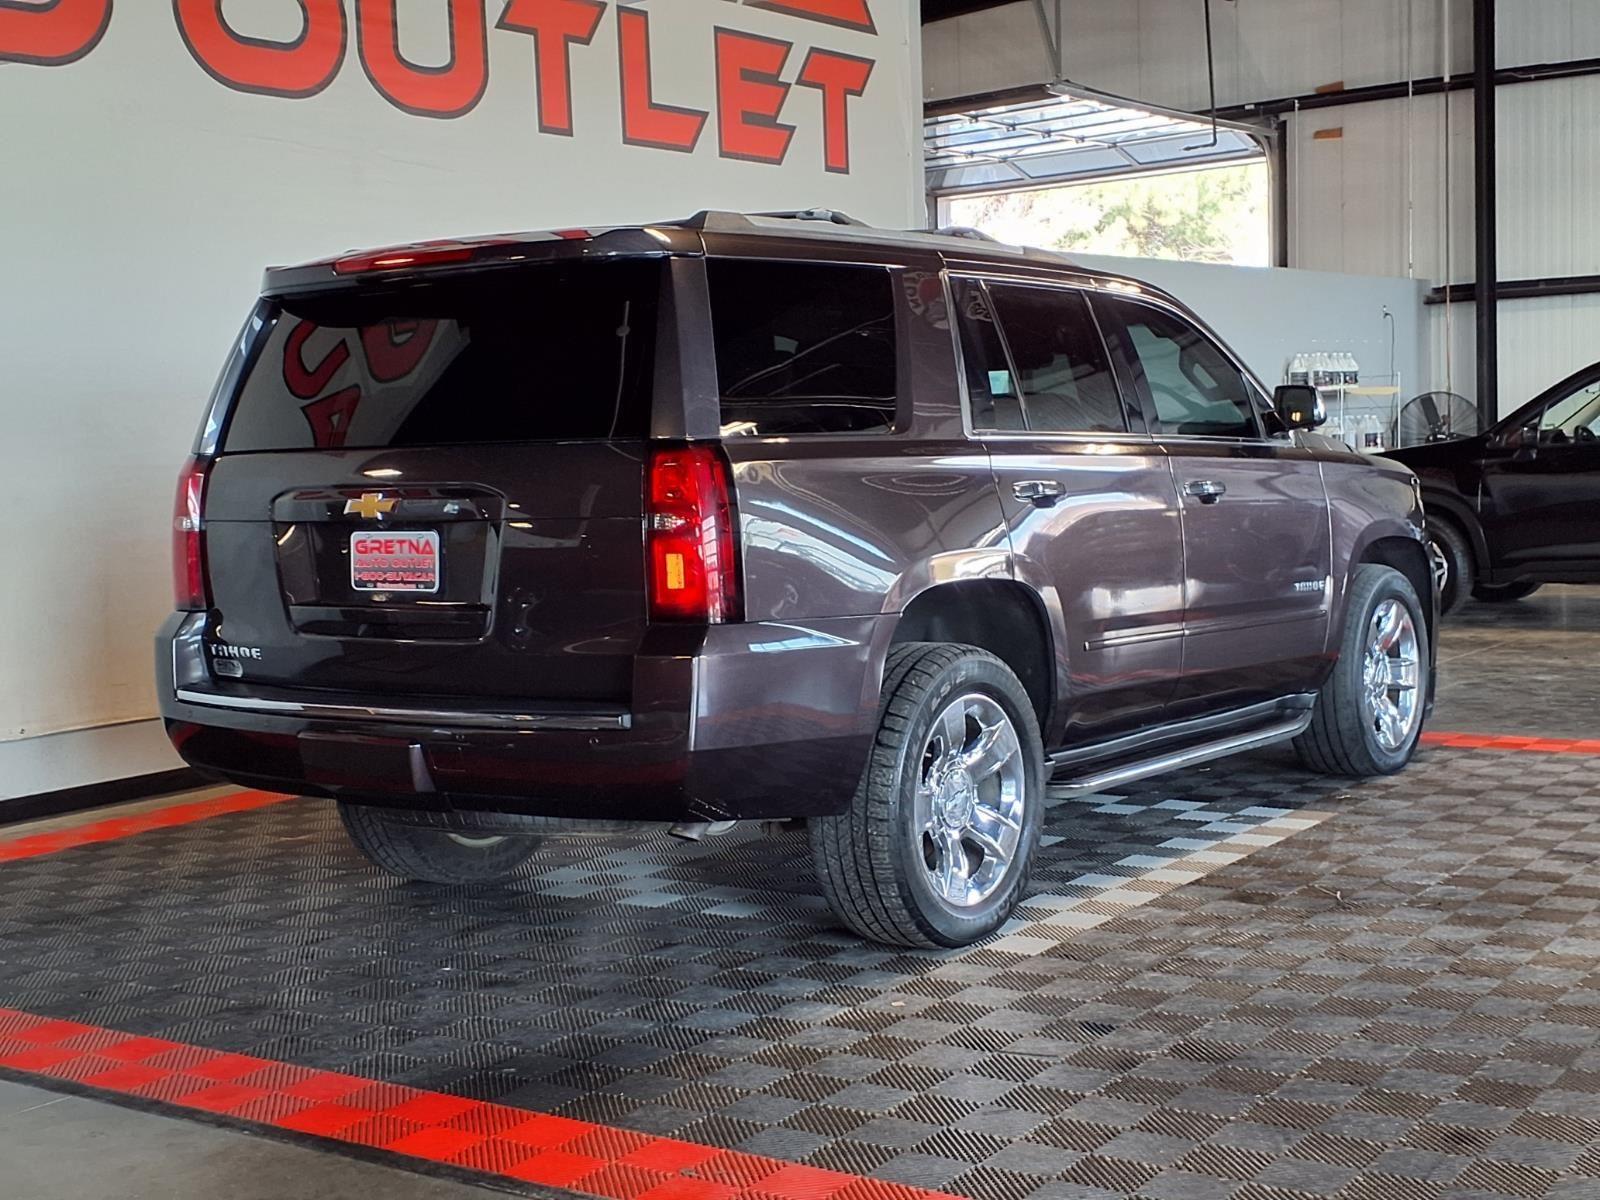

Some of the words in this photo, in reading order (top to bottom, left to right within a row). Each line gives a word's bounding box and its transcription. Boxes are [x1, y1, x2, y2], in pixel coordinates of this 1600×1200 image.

[355, 539, 434, 555] GRETNA
[354, 559, 389, 568] AUTO
[391, 559, 433, 569] OUTLET
[209, 643, 262, 660] TAHOE
